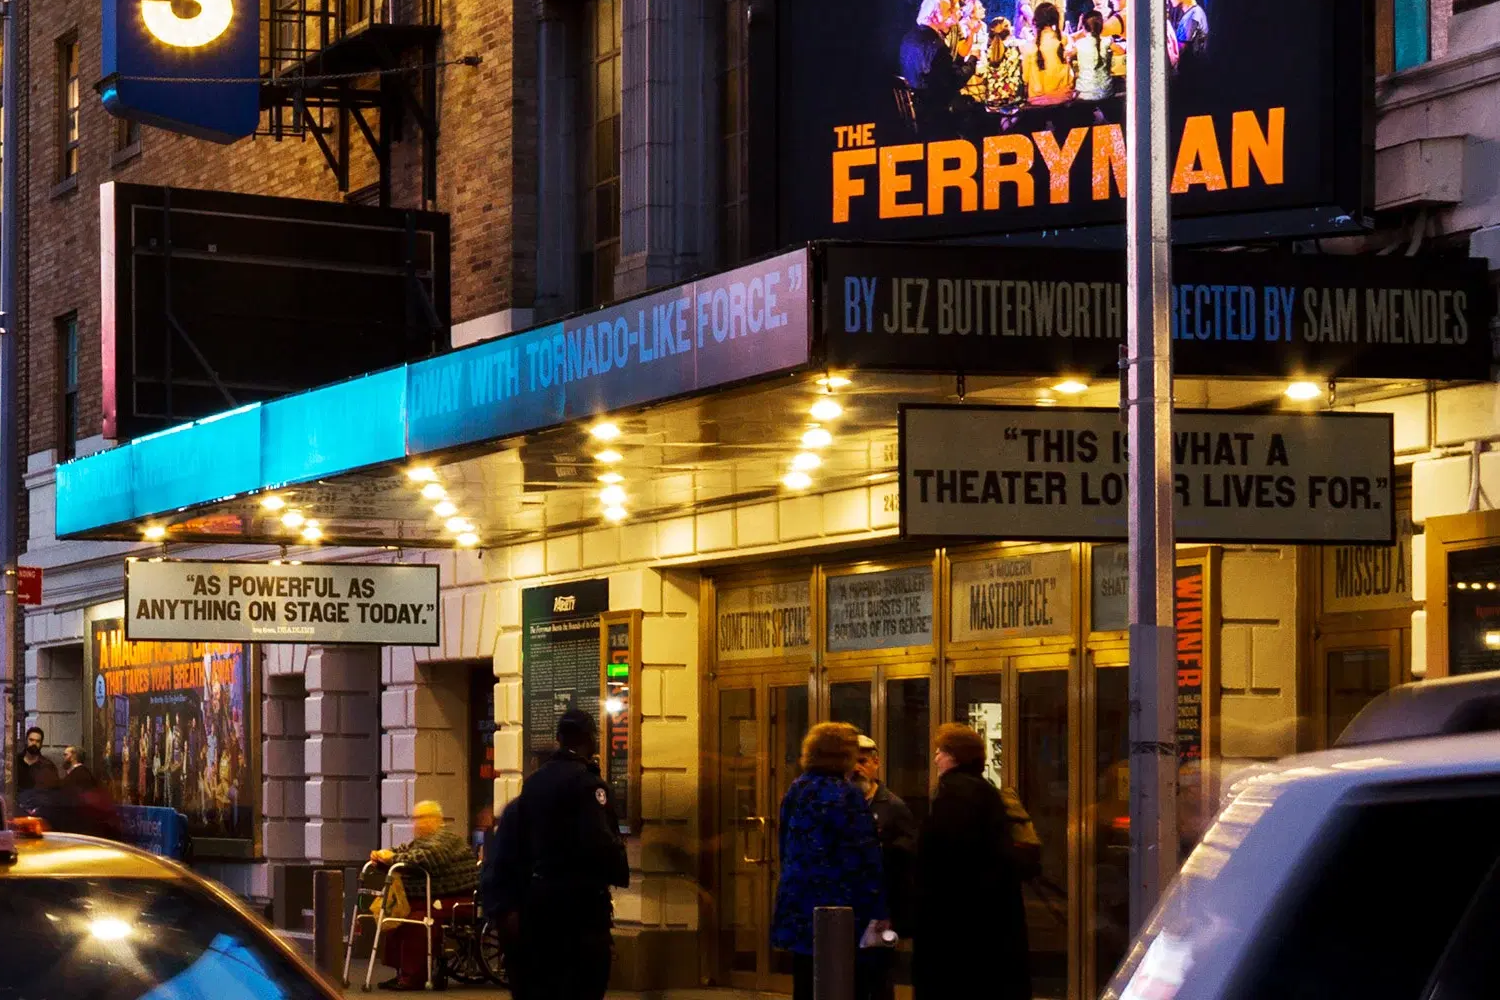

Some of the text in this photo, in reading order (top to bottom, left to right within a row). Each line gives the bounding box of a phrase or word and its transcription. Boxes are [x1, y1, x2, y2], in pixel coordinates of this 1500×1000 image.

[833, 122, 877, 149] THE
[843, 276, 1469, 346] BY JEZ BUTTERWORTH ECTED BY SAM MENDES
[469, 346, 521, 405] WITH
[525, 296, 693, 394] TORNADO-LIKE
[1003, 428, 1098, 463] “THIS
[1112, 430, 1129, 464] I
[1263, 433, 1289, 467] A
[913, 469, 1068, 505] THEATER
[1080, 471, 1191, 507] LOR
[1202, 474, 1296, 509] LIVES
[186, 574, 376, 600] “AS POWERFUL AS
[1335, 547, 1392, 598] MISSED
[135, 599, 435, 625] ANYTHING ON STAGE TODAY.”
[1176, 573, 1203, 687] WINNER
